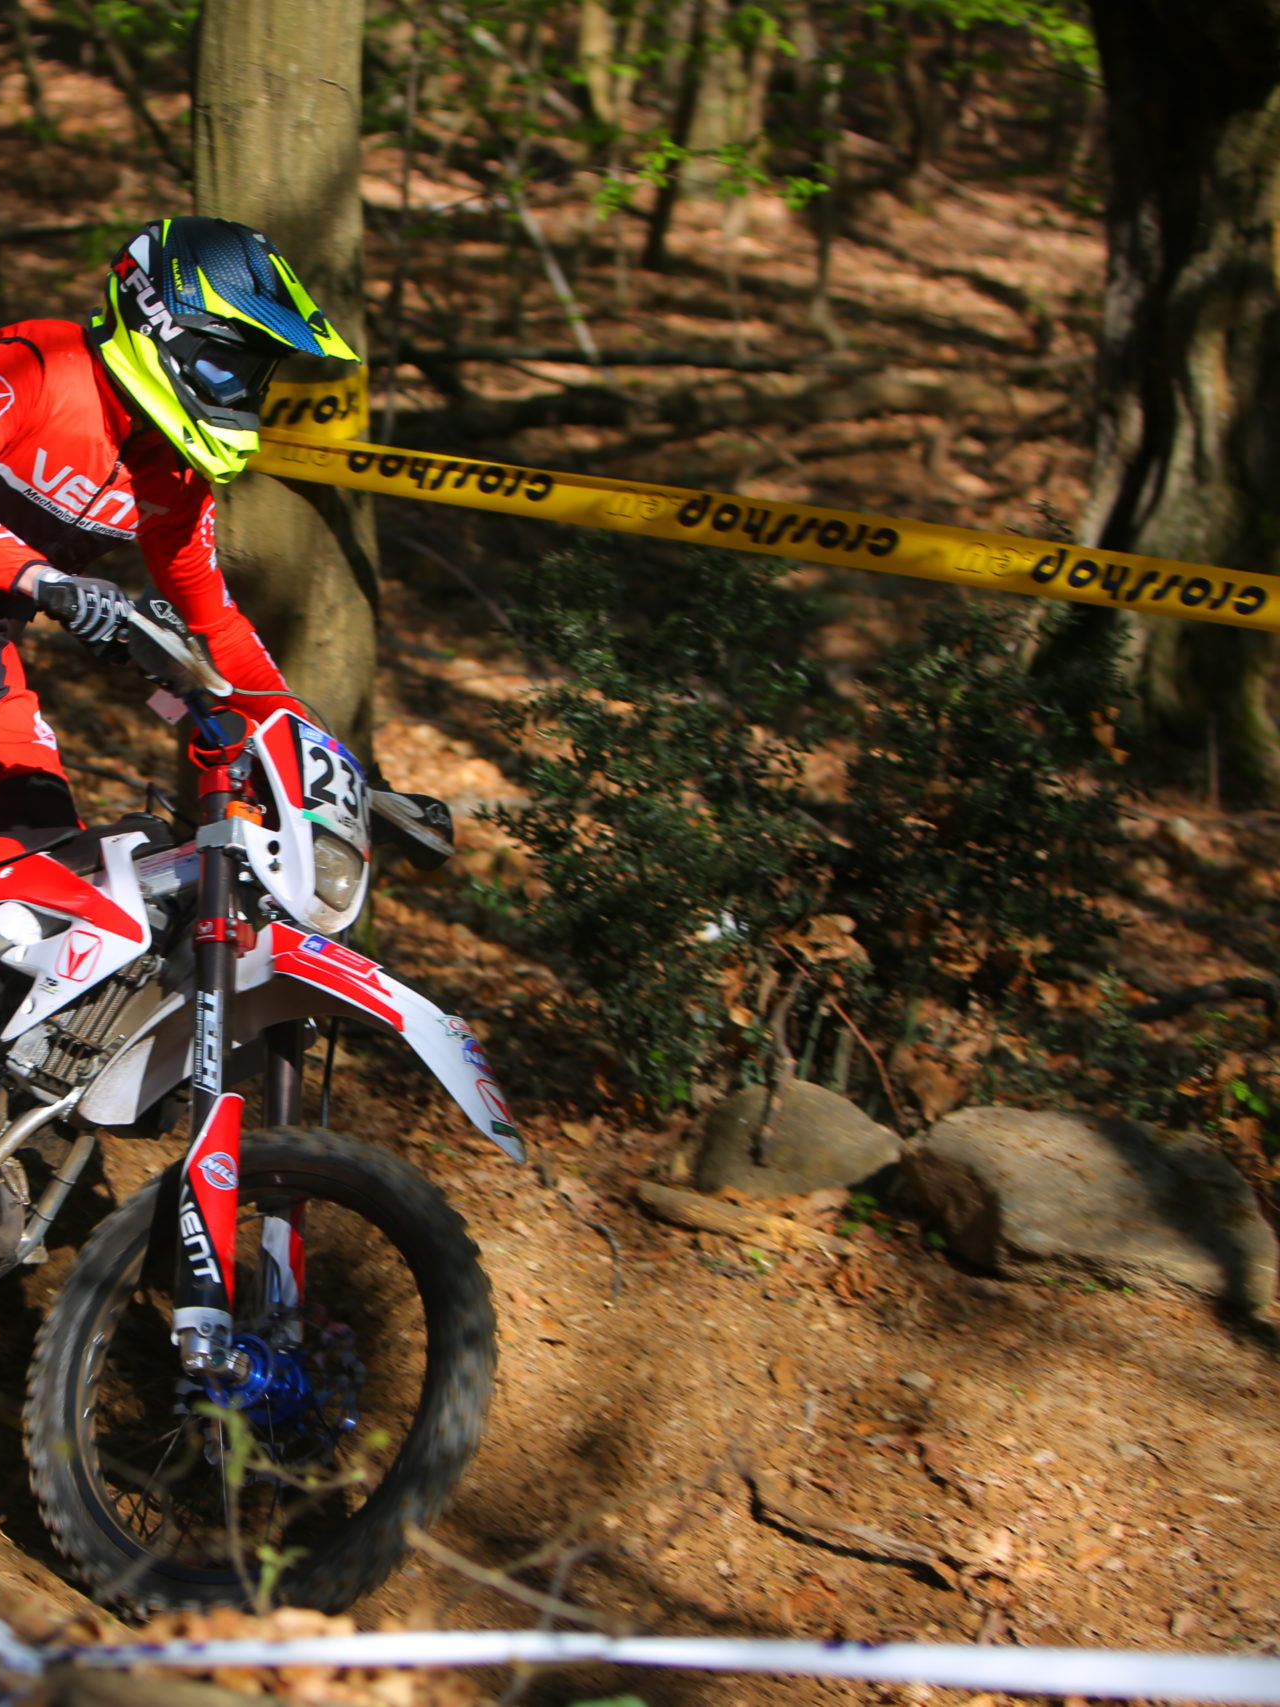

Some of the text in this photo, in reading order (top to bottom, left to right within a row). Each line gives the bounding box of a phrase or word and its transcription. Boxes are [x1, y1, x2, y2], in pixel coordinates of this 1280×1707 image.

[32, 447, 170, 530] VENT
[308, 746, 368, 828] 23
[179, 1183, 222, 1284] VENT
